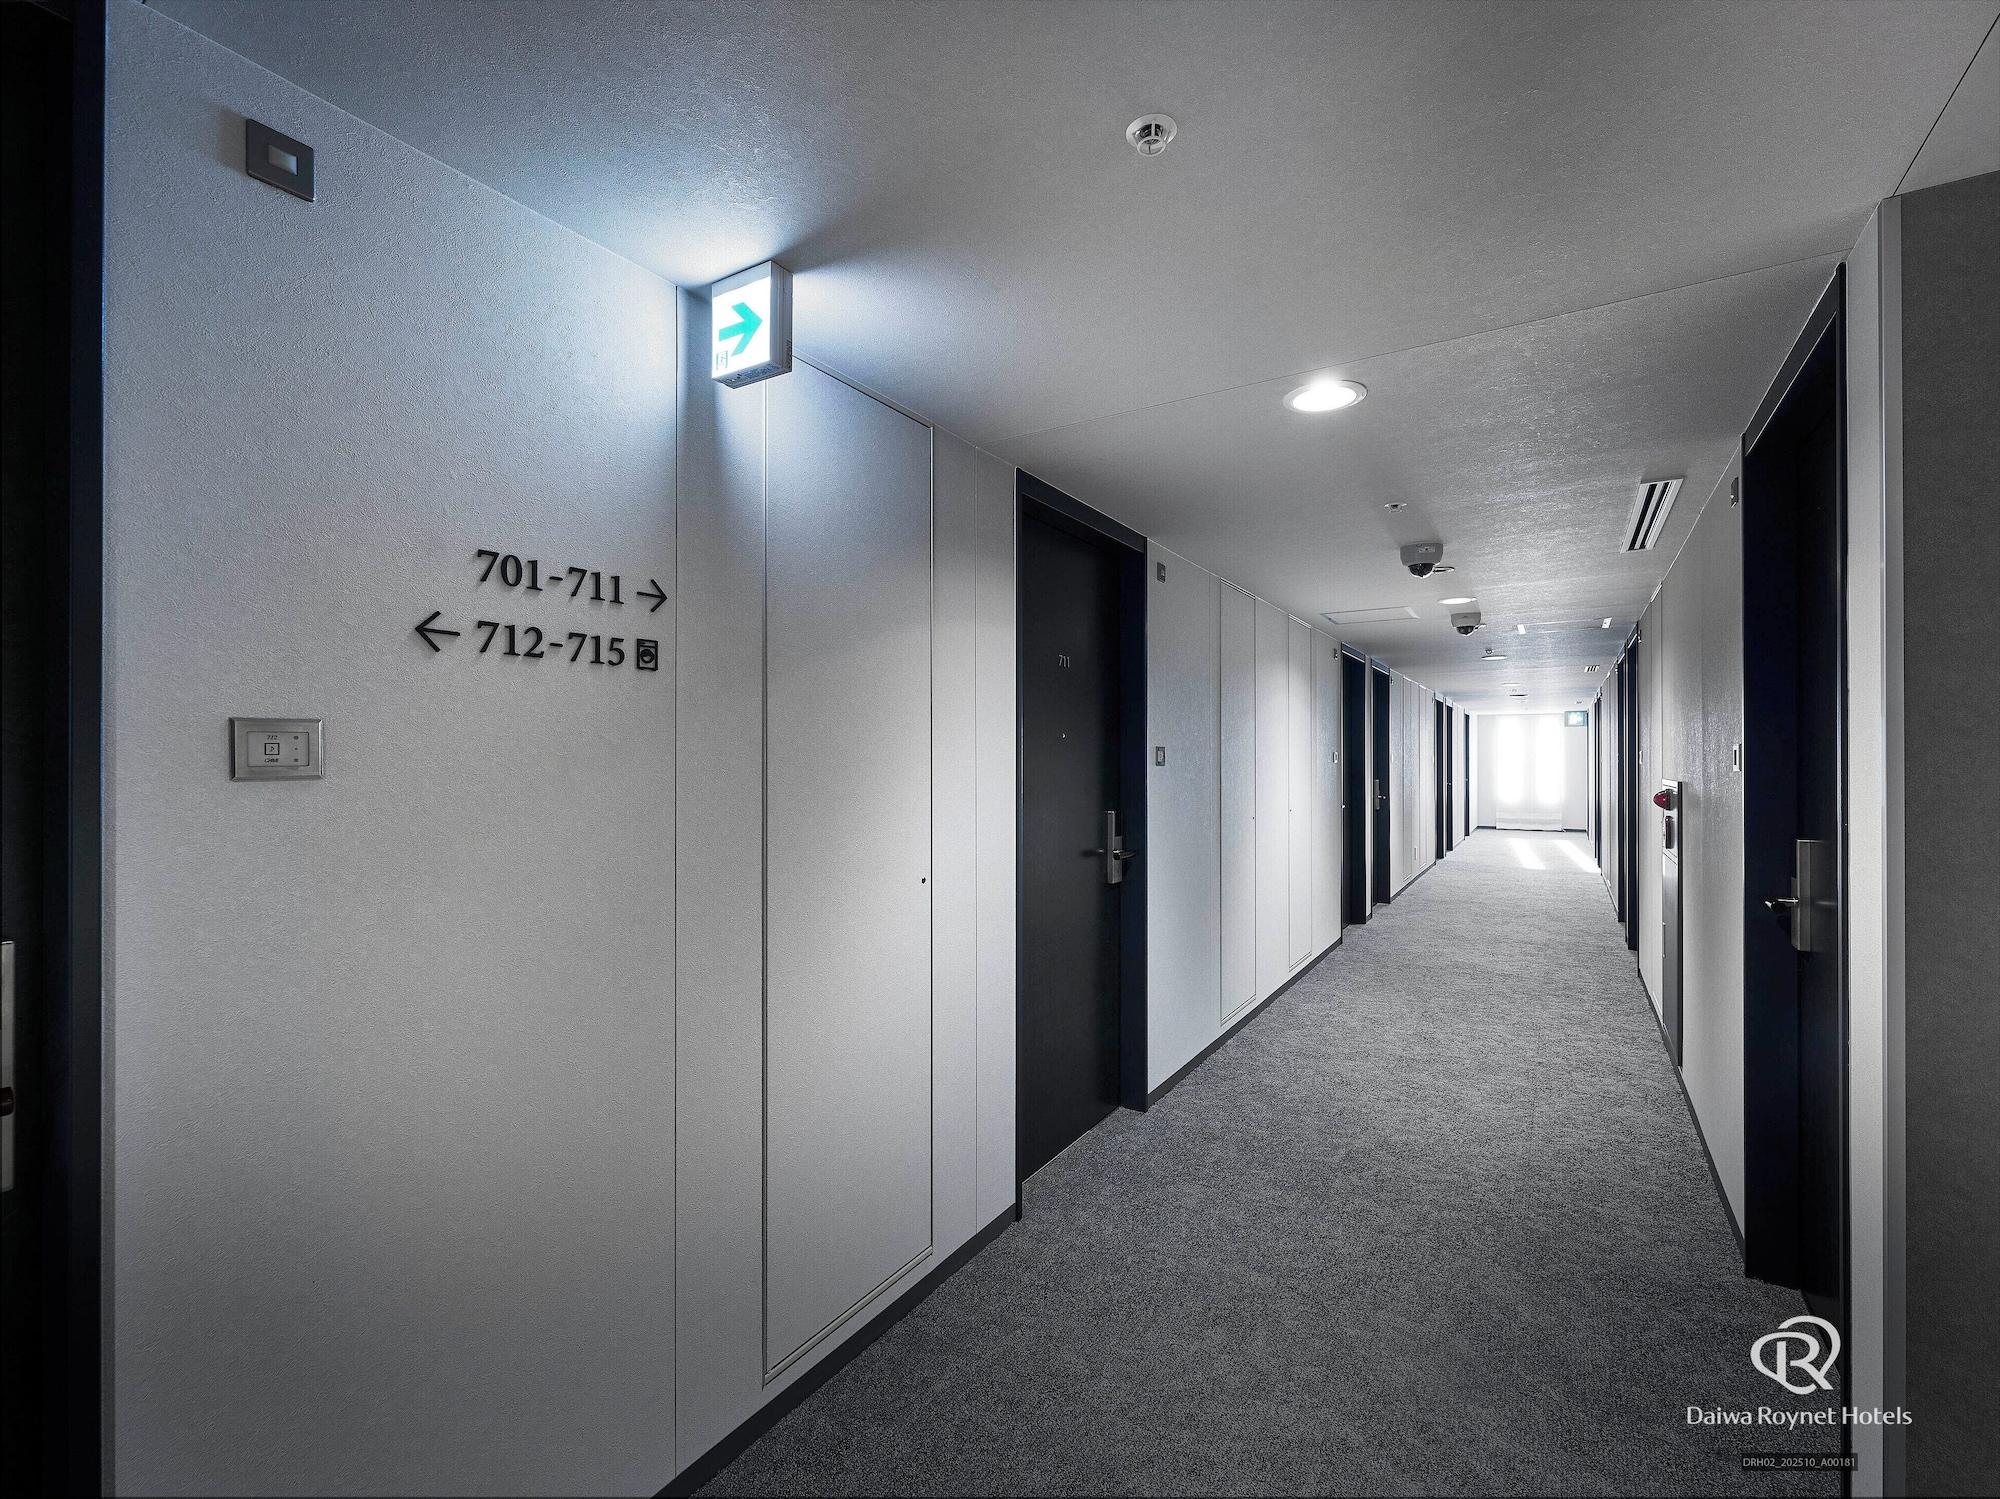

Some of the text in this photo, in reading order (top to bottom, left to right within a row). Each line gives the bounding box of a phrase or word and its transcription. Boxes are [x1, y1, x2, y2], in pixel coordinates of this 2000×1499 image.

[477, 549, 624, 604] 701-711
[477, 620, 625, 666] 712-715
[1058, 654, 1070, 668] 711
